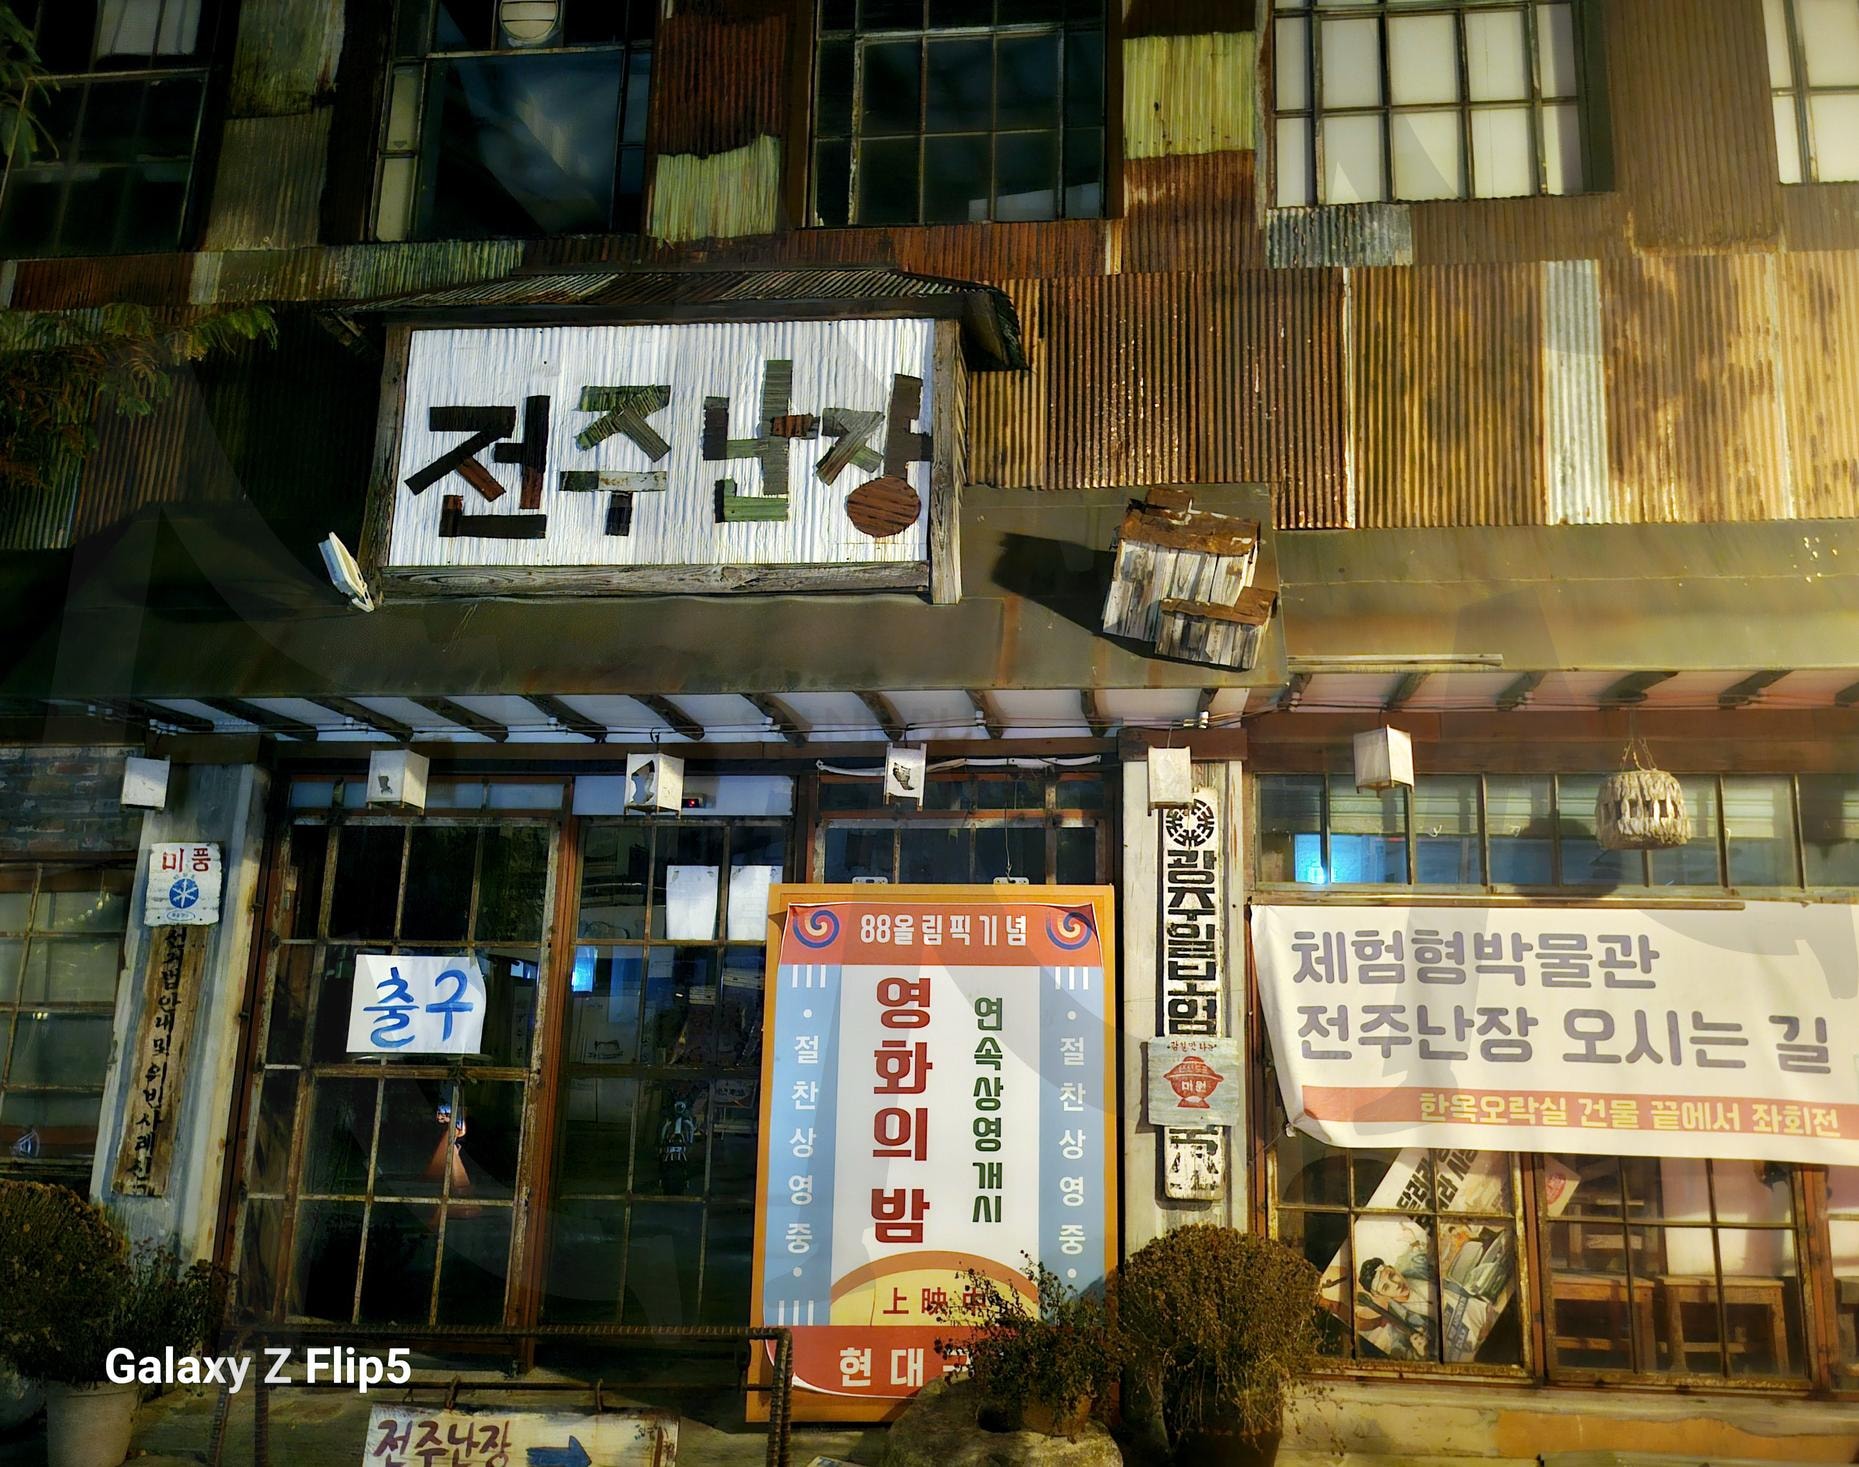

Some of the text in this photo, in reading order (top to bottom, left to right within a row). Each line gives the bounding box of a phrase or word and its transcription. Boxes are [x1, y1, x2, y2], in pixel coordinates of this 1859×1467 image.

[404, 360, 932, 538] 전주난장
[162, 848, 211, 872] 미풍
[1292, 929, 1660, 989] 체험형박물관
[363, 967, 473, 1048] 출구
[1297, 1004, 1831, 1074] 전주난장 오시는 길
[1419, 1092, 1841, 1138] 한옥오락실 건물 끝에서 좌회전
